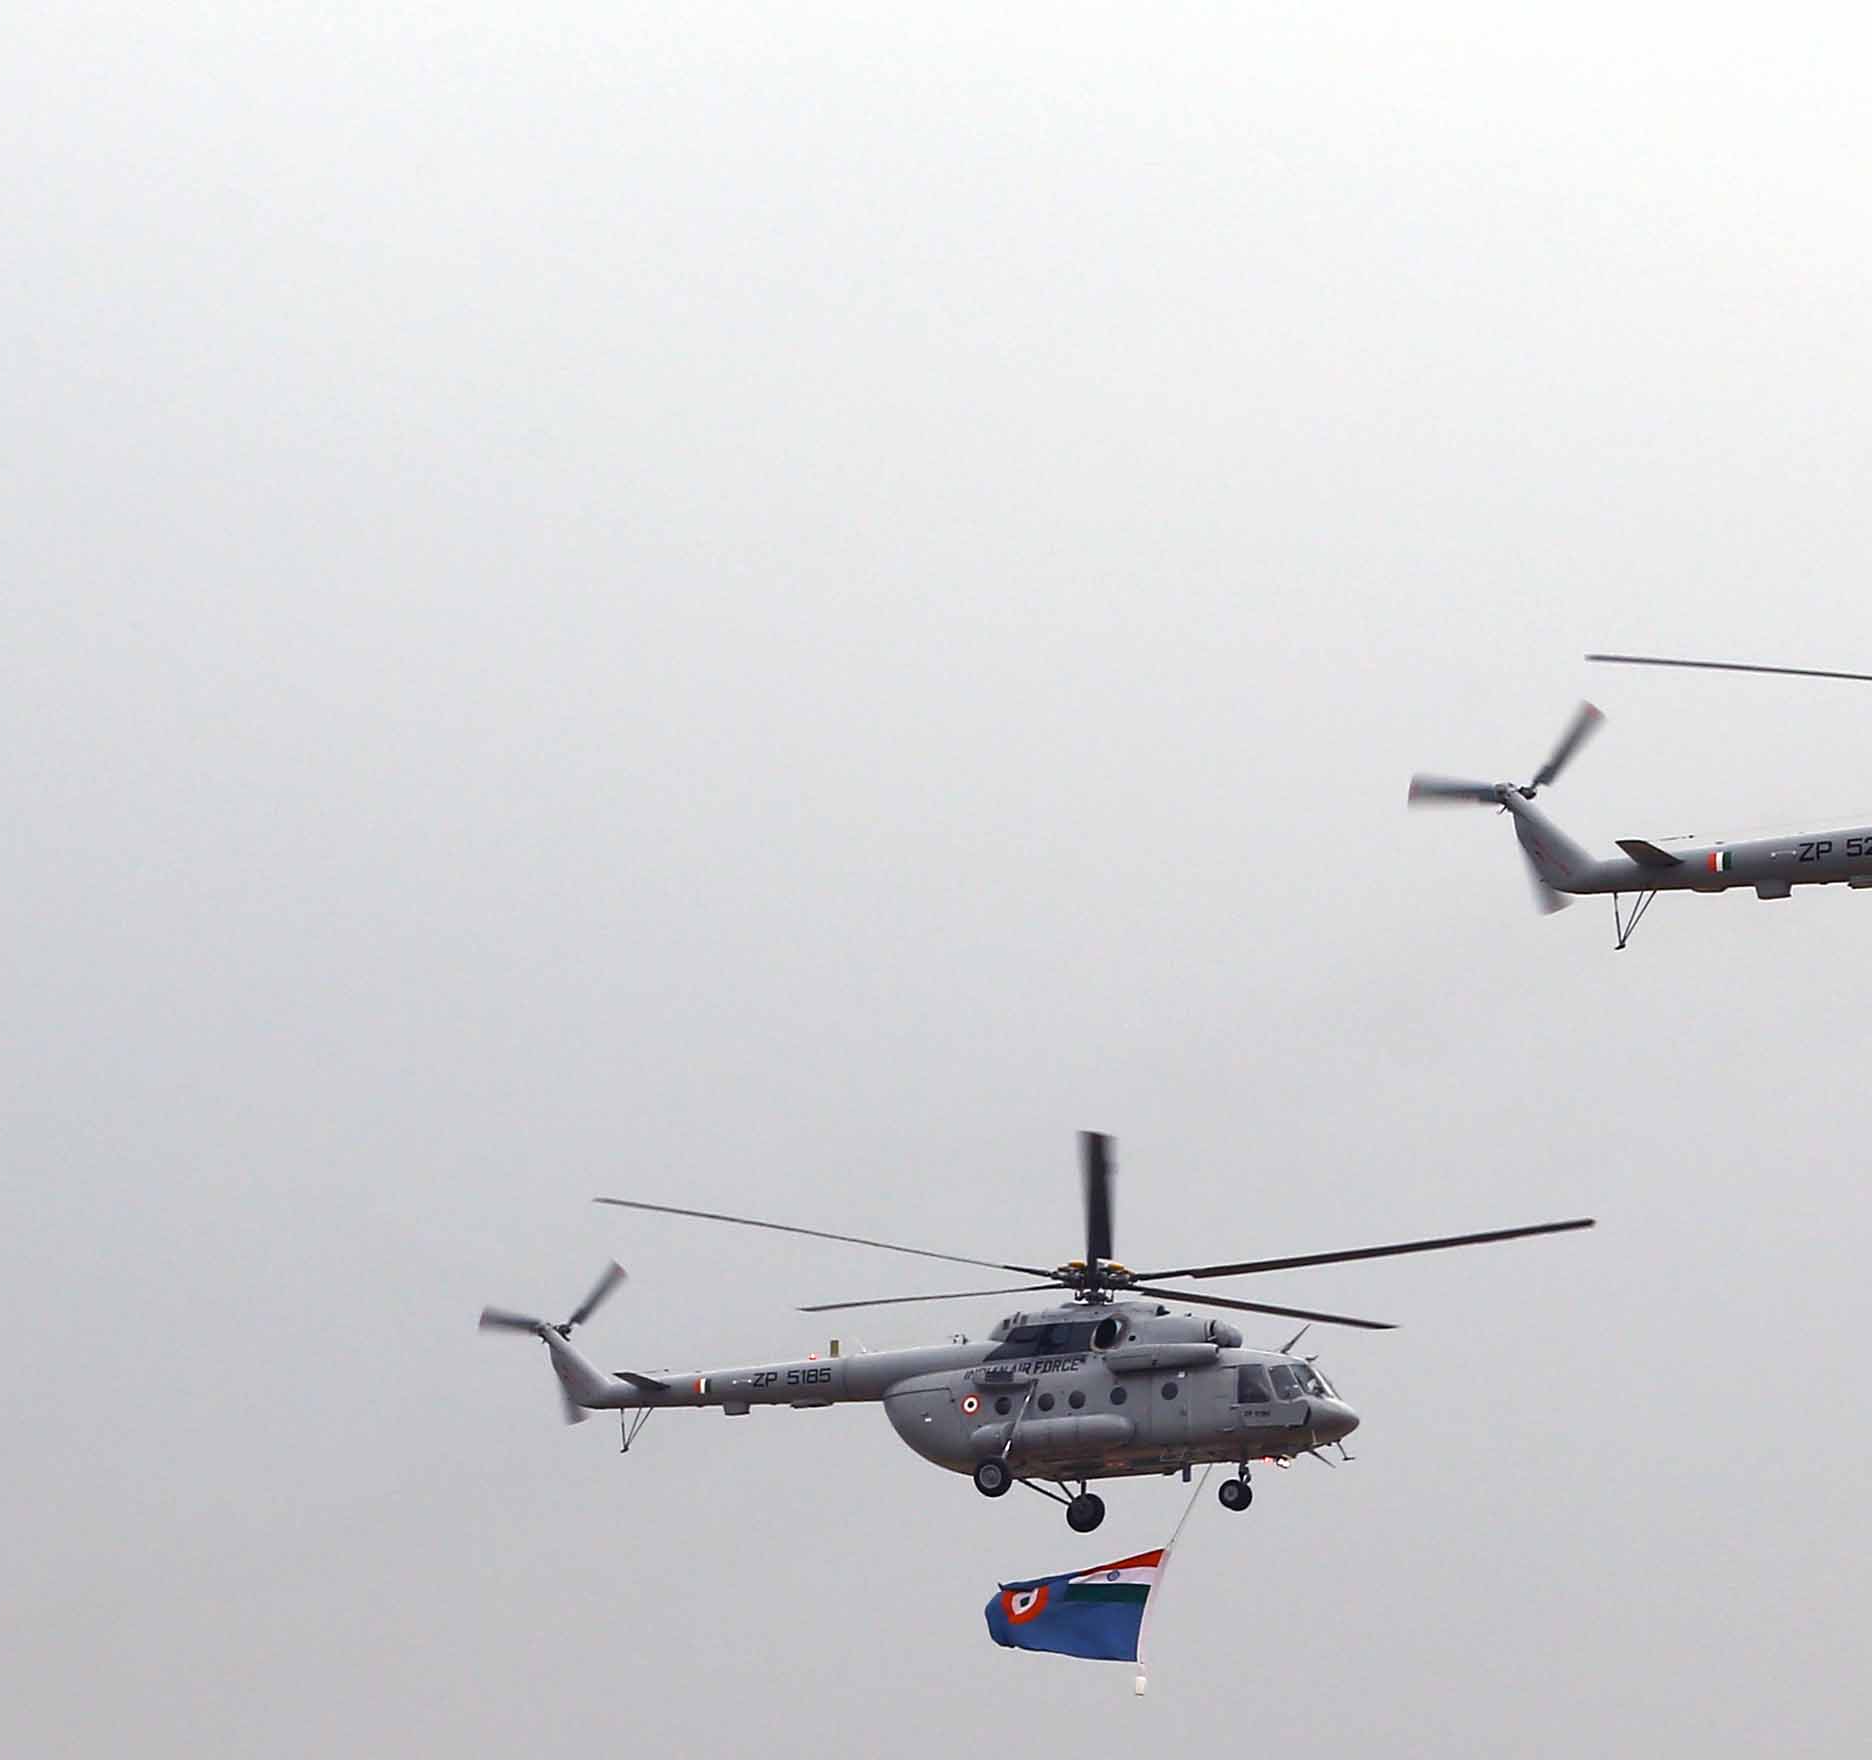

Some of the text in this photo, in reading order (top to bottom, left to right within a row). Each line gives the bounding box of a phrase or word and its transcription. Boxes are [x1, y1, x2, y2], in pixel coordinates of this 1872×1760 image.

[1799, 841, 1833, 862] ZP
[1033, 1358, 1080, 1375] FORCE
[752, 1367, 832, 1388] ZP 5185
